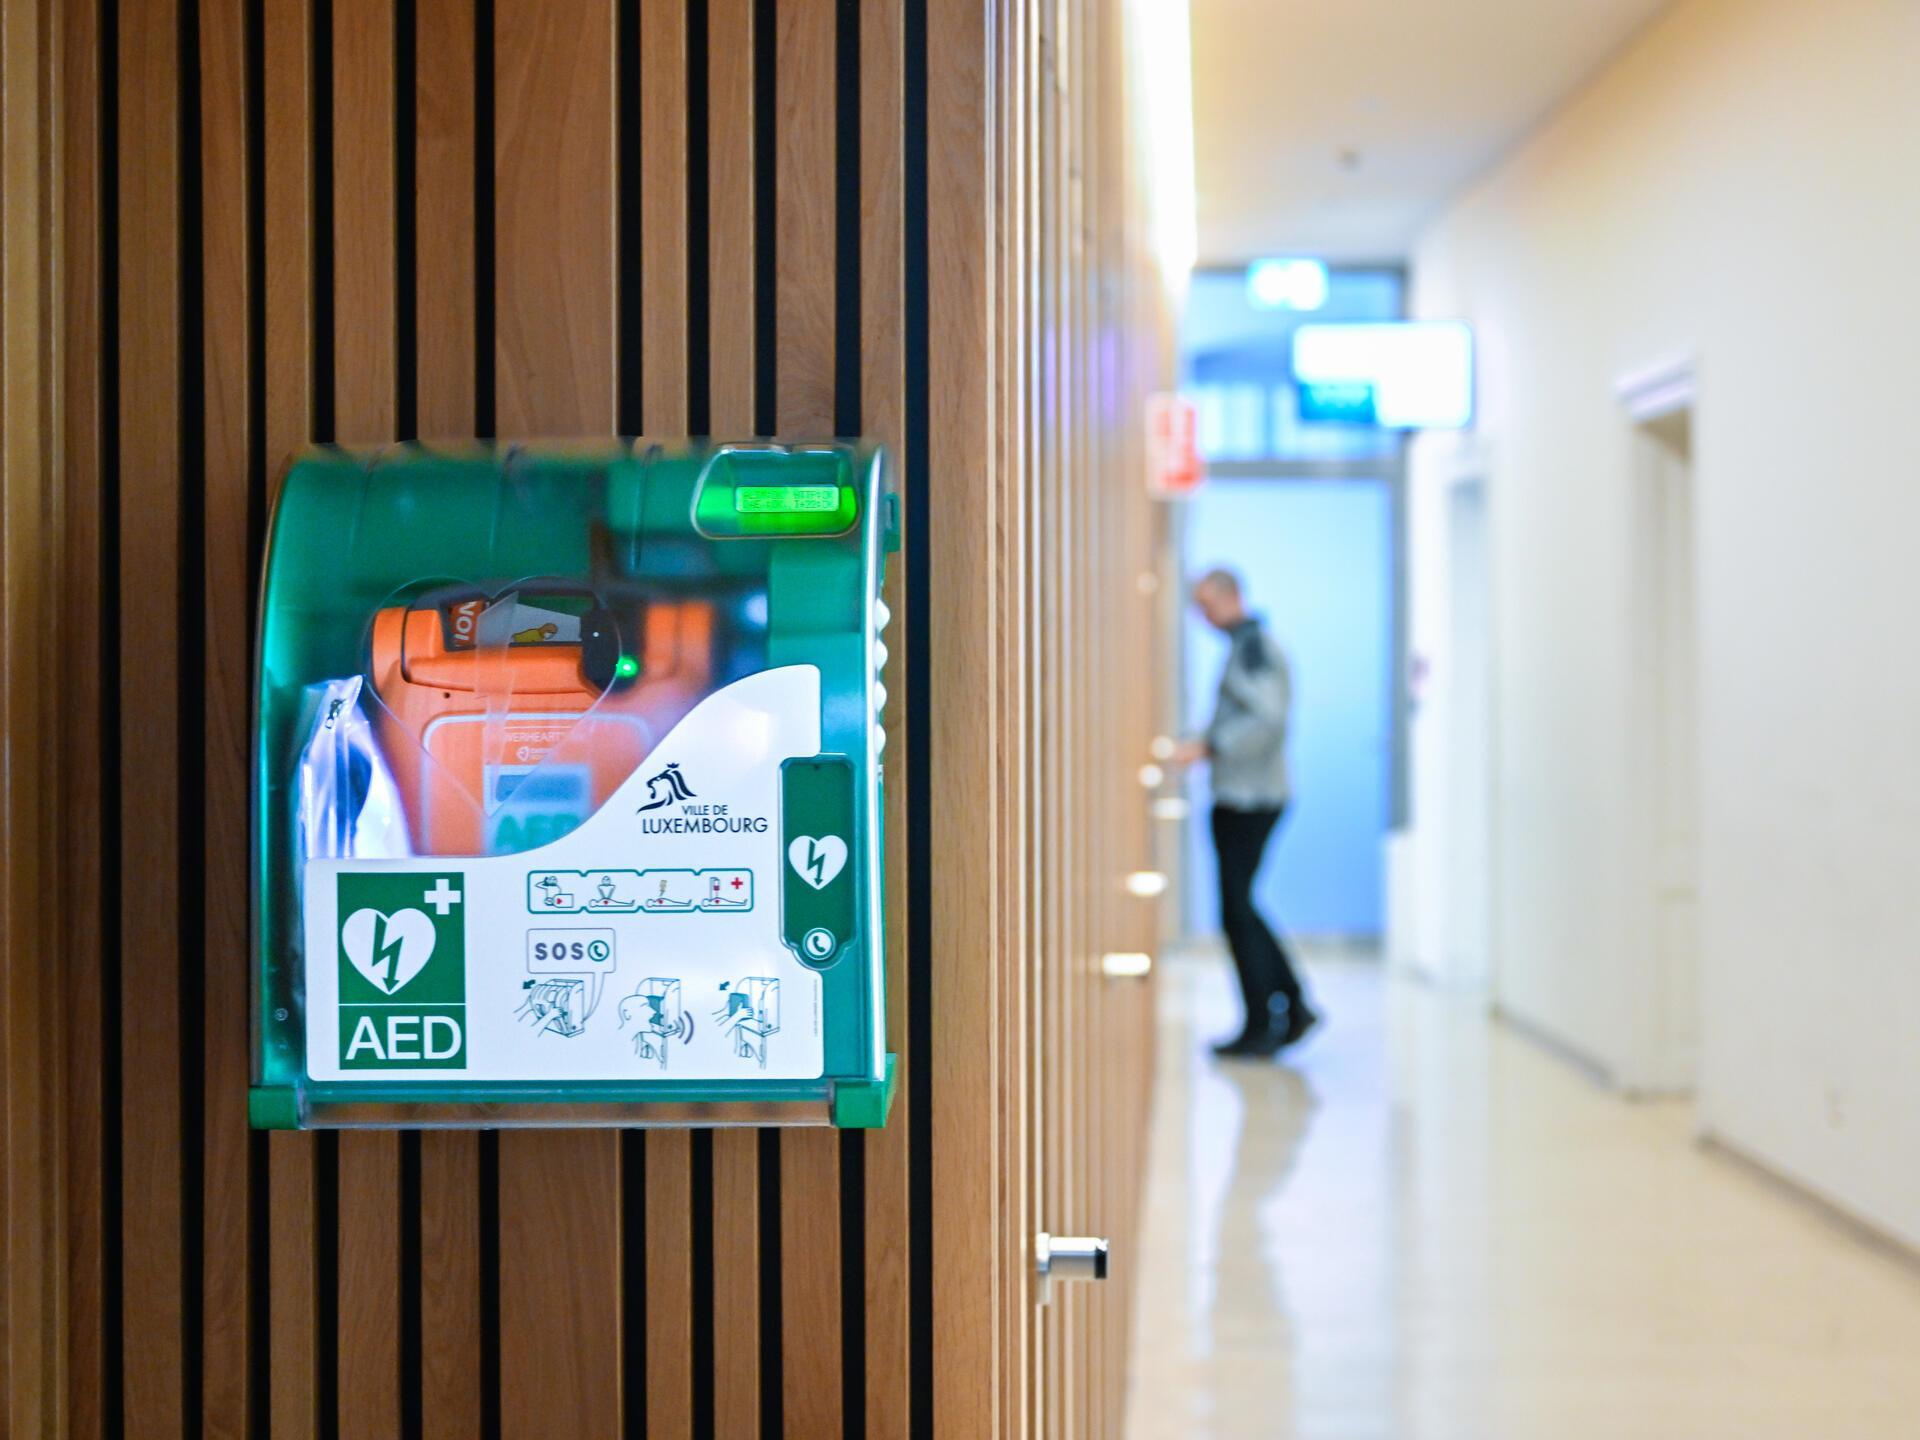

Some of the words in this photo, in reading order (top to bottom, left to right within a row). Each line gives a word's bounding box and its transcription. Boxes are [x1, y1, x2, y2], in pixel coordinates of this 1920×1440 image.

[681, 804, 709, 815] VILLE
[713, 804, 728, 815] DE
[642, 817, 768, 834] LUXEMBOURG
[535, 942, 584, 961] SOS
[345, 1015, 463, 1060] AED
